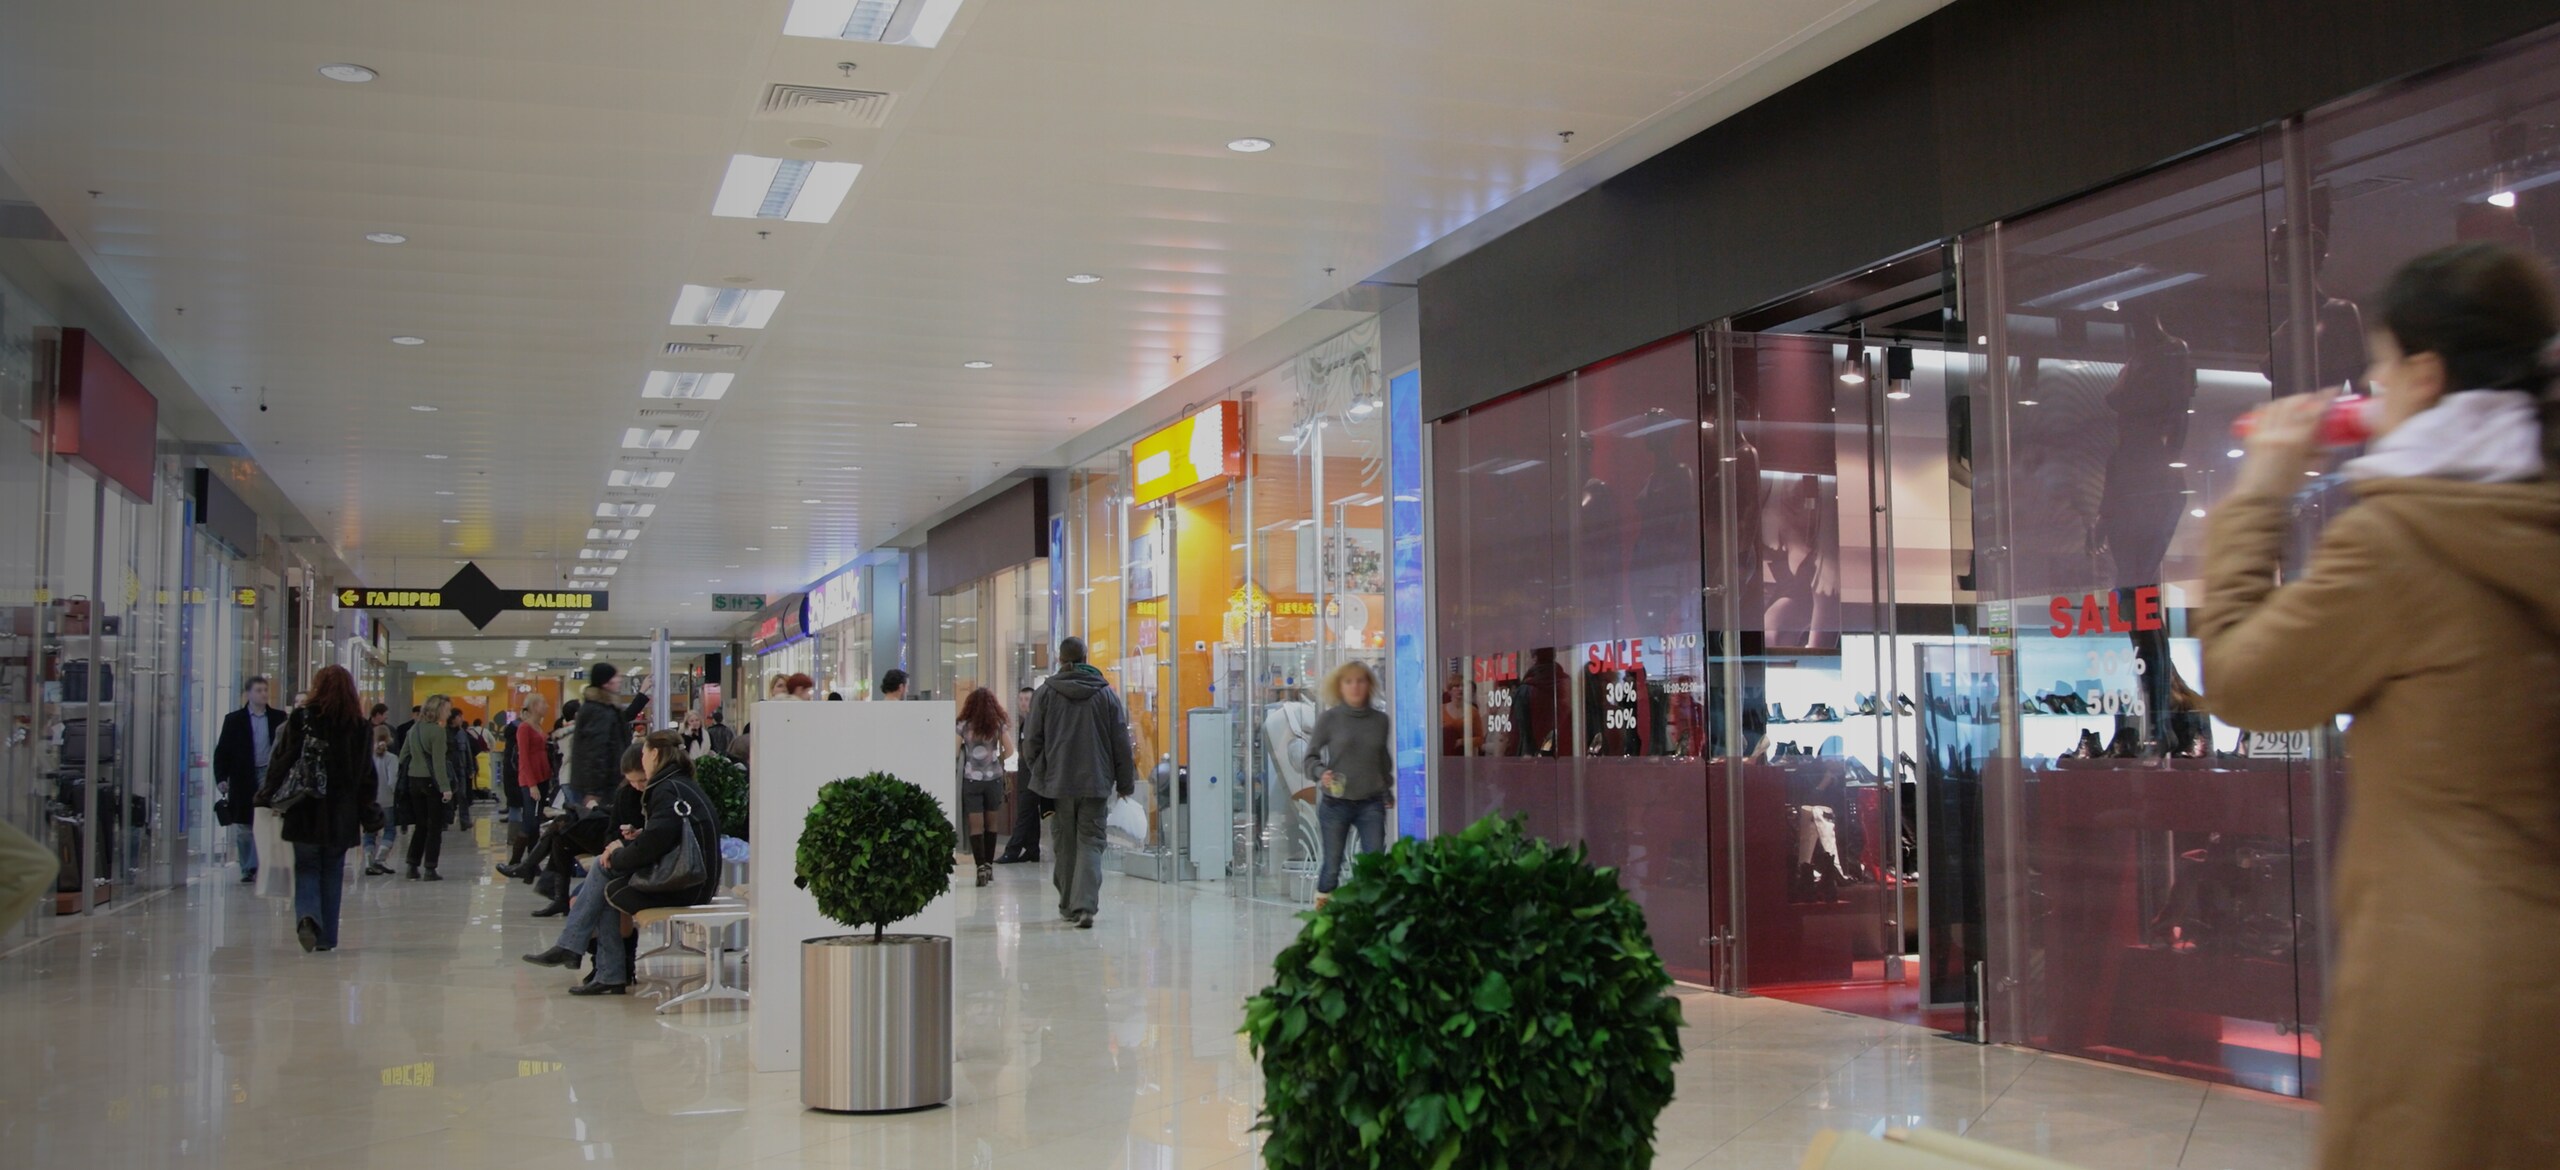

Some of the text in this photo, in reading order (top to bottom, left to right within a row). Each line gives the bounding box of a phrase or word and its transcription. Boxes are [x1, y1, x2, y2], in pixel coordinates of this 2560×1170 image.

[366, 592, 441, 606] ГАЛЕРЕЯ
[522, 594, 592, 608] GALERIE
[2049, 586, 2162, 638] SALE
[1473, 652, 1518, 683] SALE
[1588, 639, 1644, 675] SALE
[2085, 646, 2146, 676] 30%
[466, 677, 495, 692] cafe
[1606, 682, 1637, 703] 30%
[1487, 690, 1512, 708] 30%
[2085, 688, 2146, 717] 50%
[1487, 714, 1512, 732] 50%
[1606, 708, 1637, 729] 50%
[2254, 730, 2303, 751] 2990
